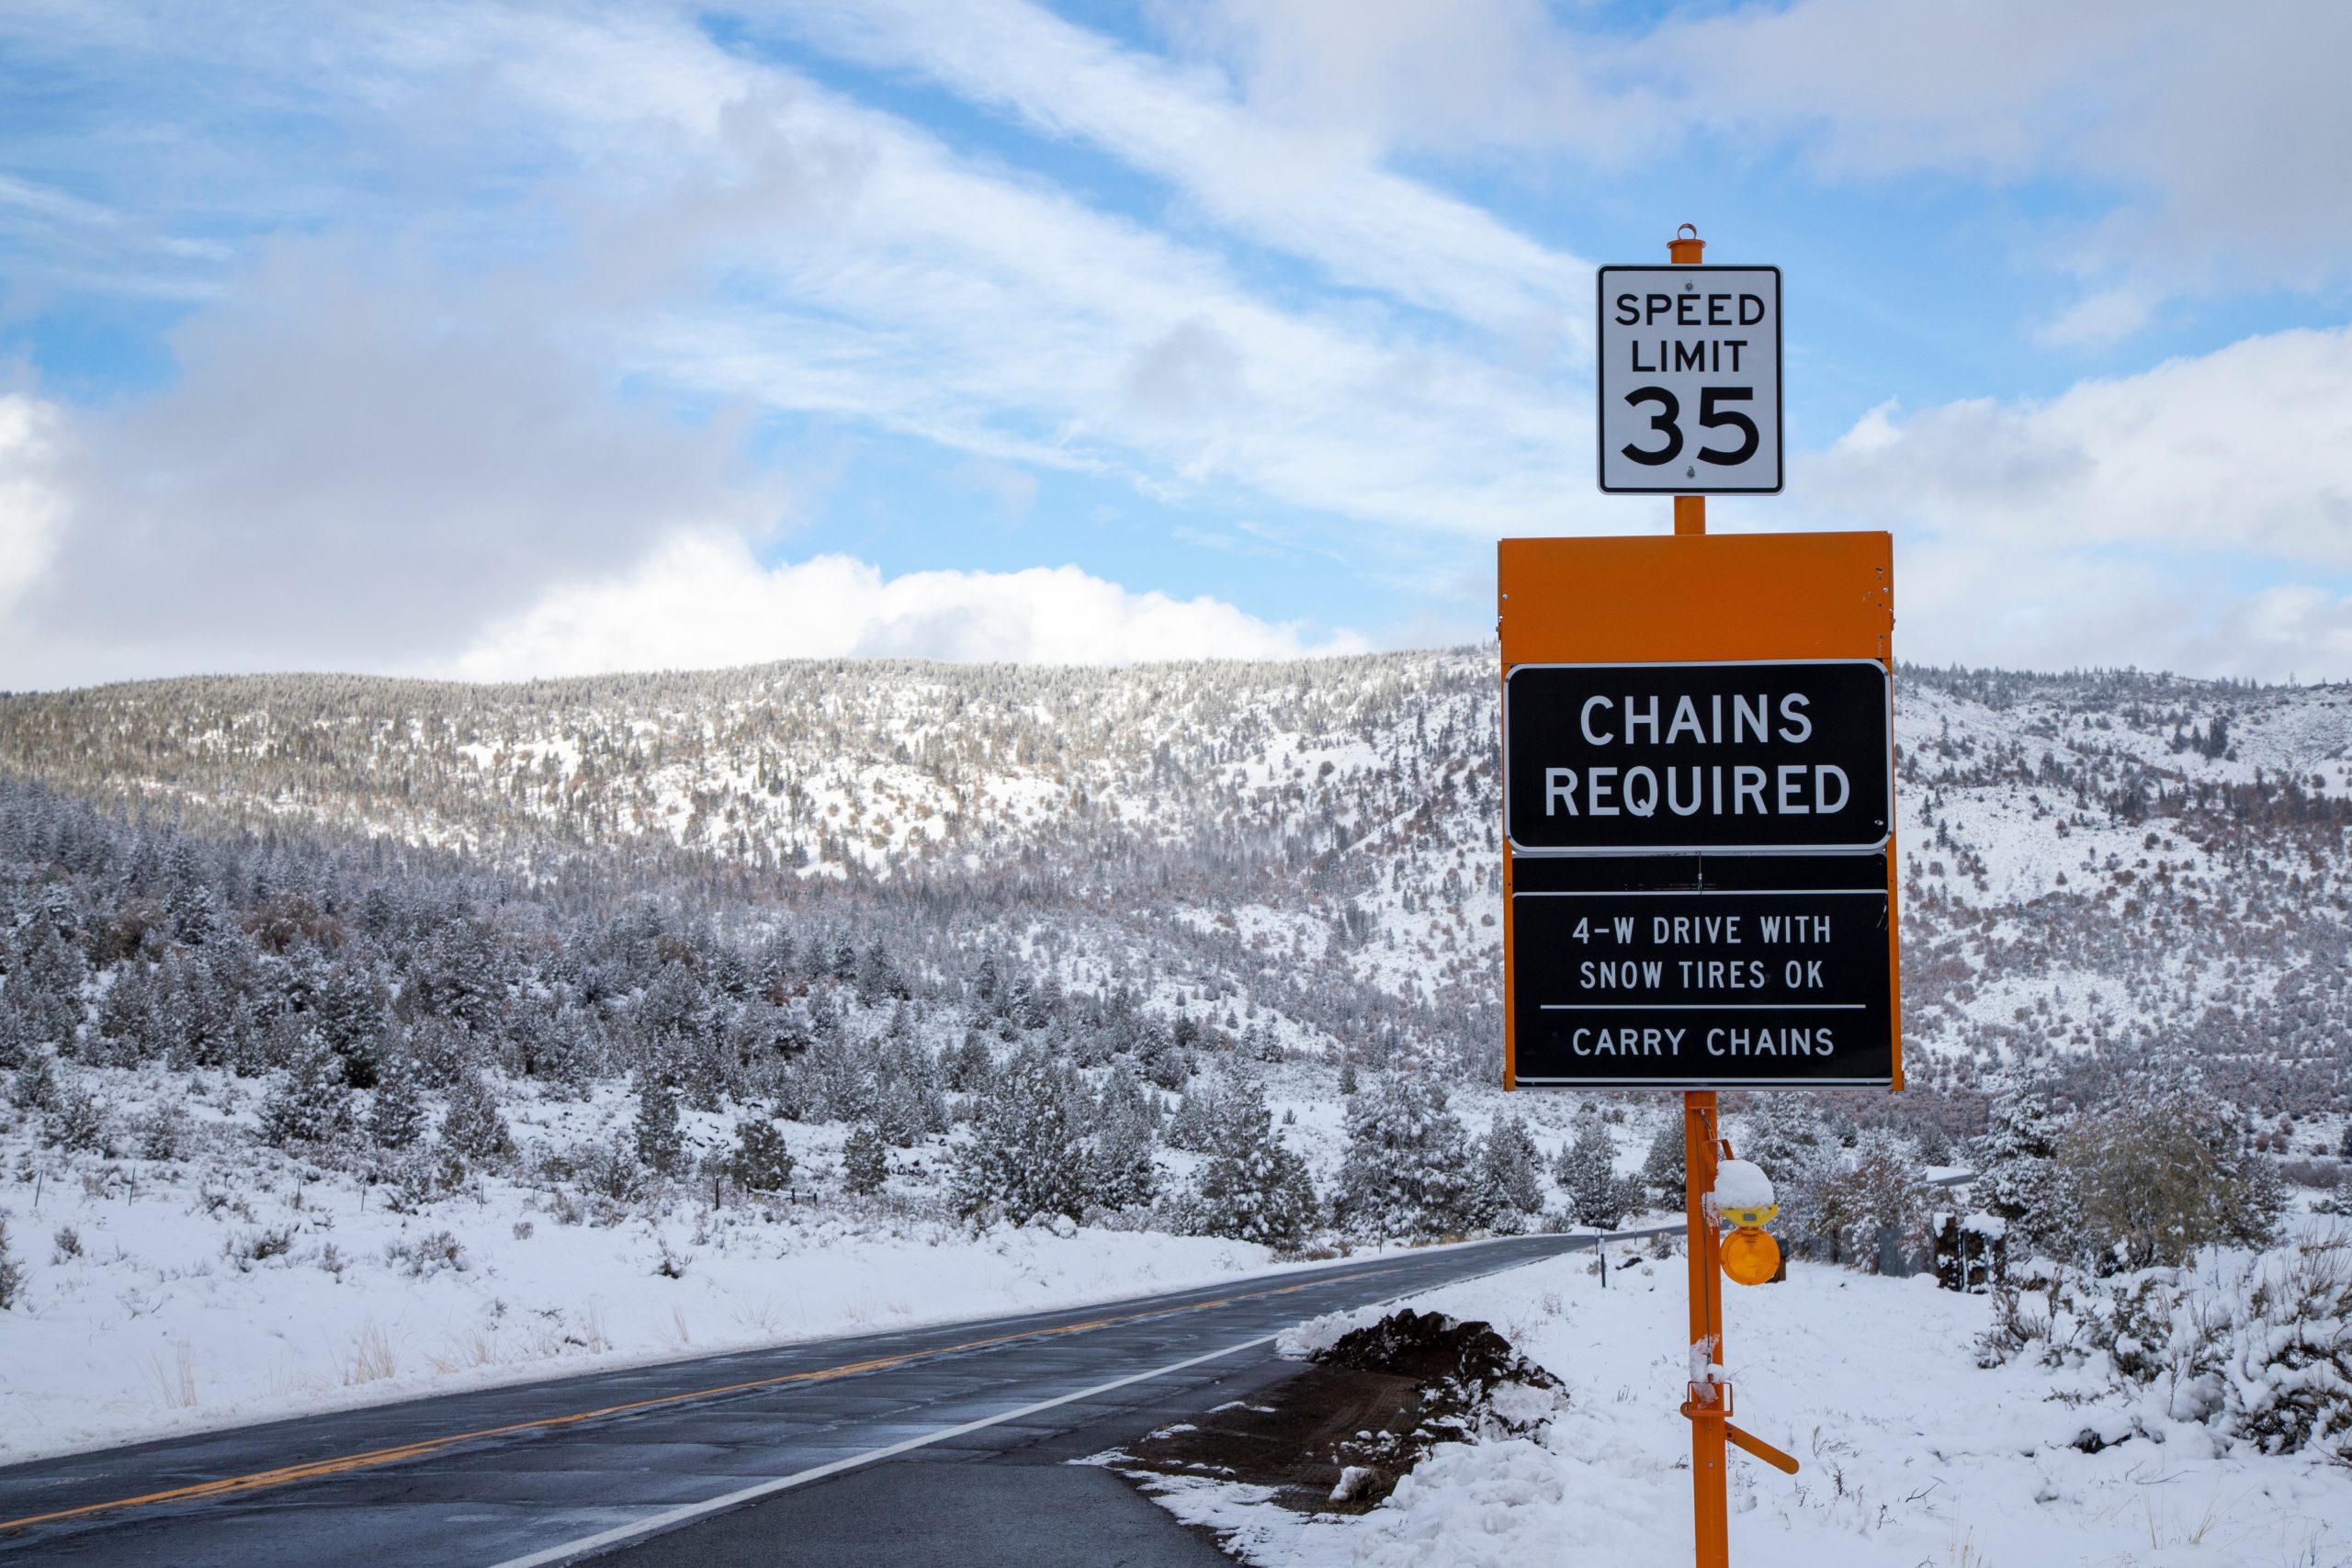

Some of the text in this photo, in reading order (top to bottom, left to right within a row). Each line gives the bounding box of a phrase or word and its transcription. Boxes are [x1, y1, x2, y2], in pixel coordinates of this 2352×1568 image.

[1615, 293, 1765, 326] SPEED
[1632, 340, 1747, 372] LIMIT
[1621, 386, 1759, 466] 35
[1580, 693, 1812, 746] CHAINS
[1545, 764, 1850, 818] REQUIRED
[1572, 915, 1831, 944] 4-W DRIVE WITH
[1579, 960, 1824, 989] SNOW TIRES OK
[1572, 1027, 1834, 1056] CARRY CHAINS
